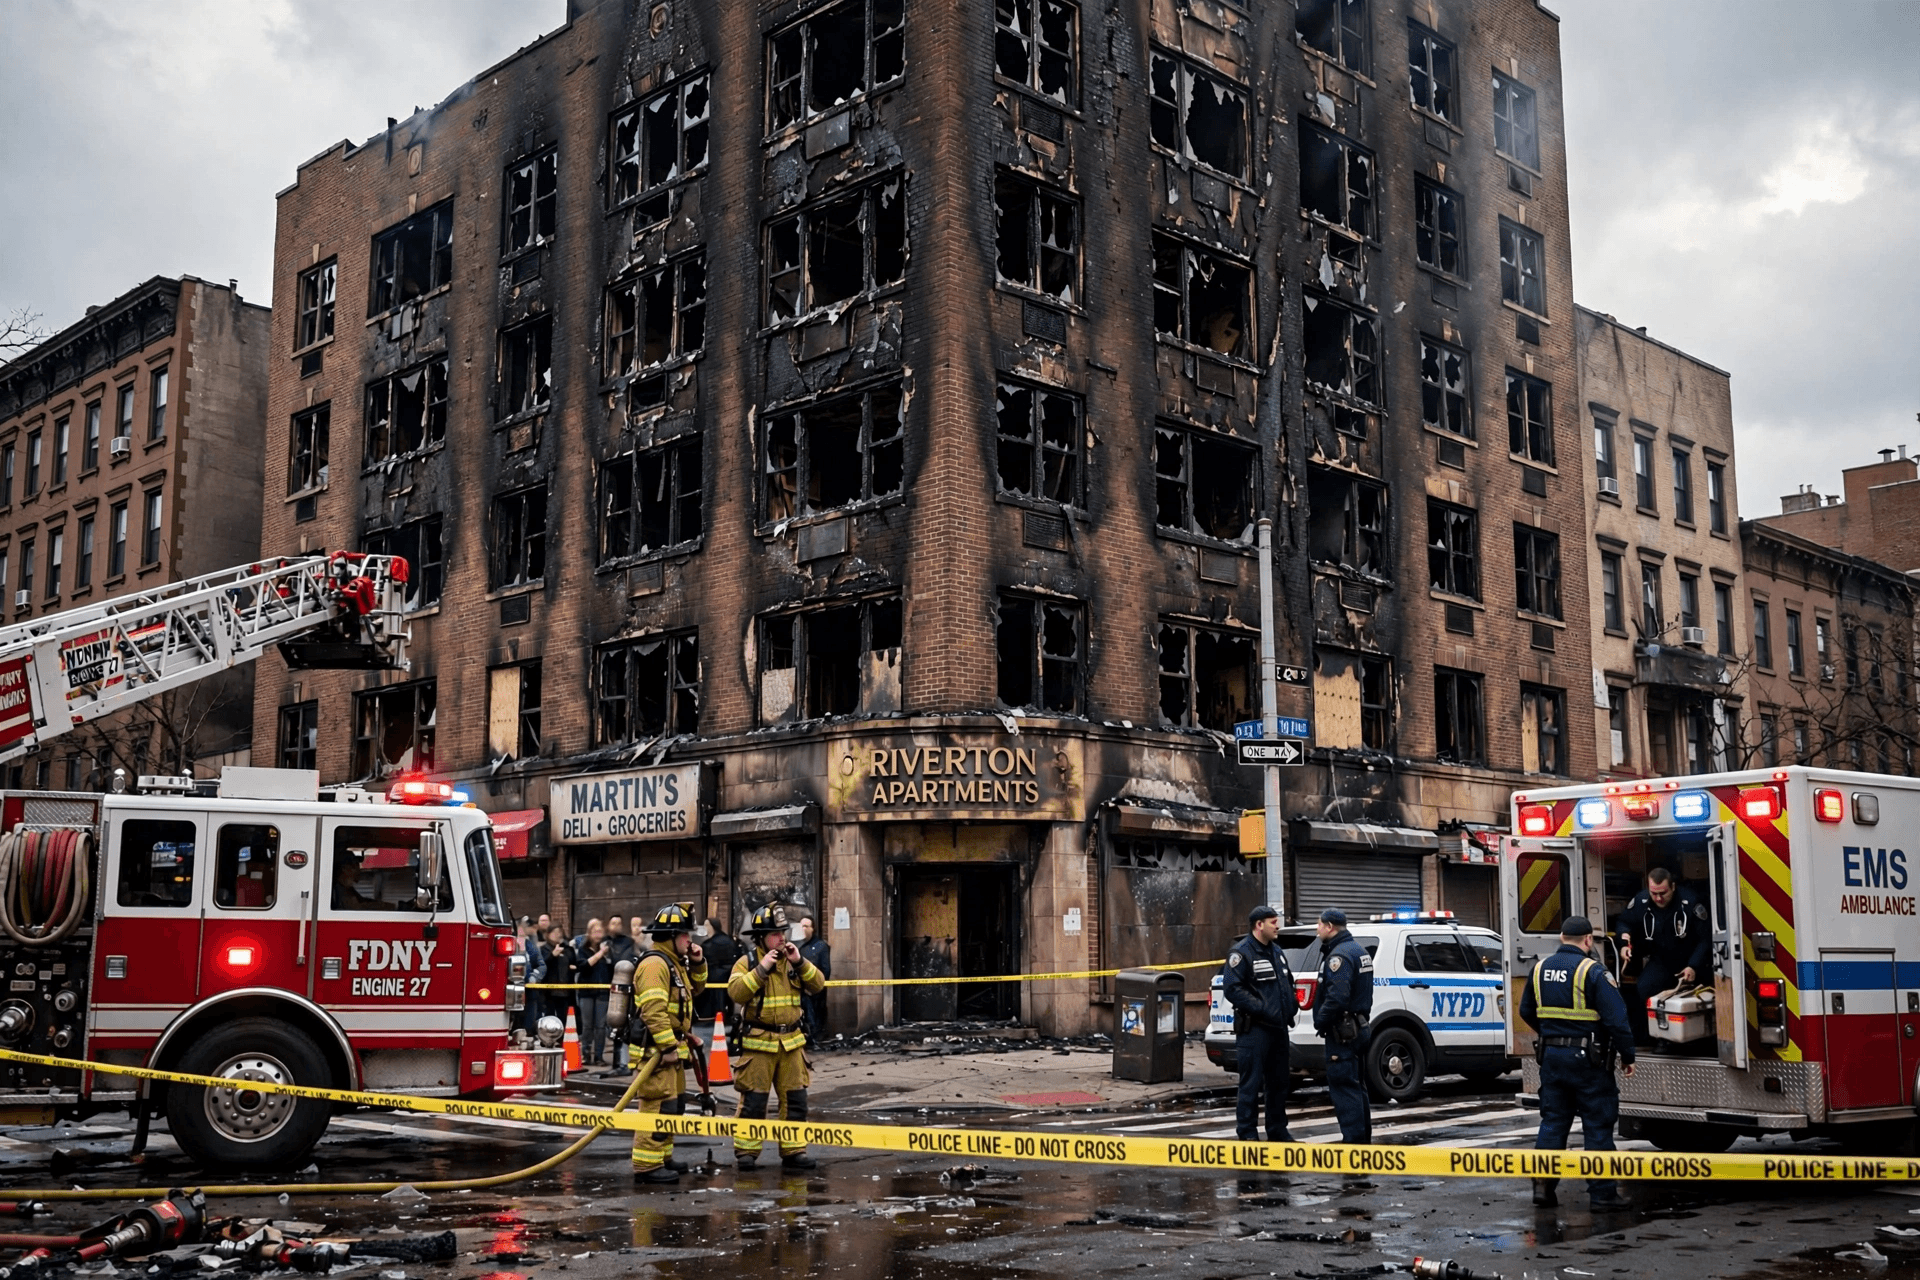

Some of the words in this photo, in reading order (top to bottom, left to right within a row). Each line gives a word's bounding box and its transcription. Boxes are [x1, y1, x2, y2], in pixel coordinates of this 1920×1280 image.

[869, 746, 1037, 777] RIVERTON
[1247, 747, 1266, 756] ONE
[571, 773, 679, 814] MARTIN'S
[872, 780, 1039, 804] APARTMENTS
[563, 817, 591, 839] DELI
[608, 809, 686, 836] GROCERIES
[1842, 846, 1908, 890] EMS
[1840, 894, 1916, 916] AMBULANCE
[352, 977, 405, 996] ENGINE
[409, 977, 431, 996] 27
[1543, 969, 1568, 983] EMS
[1431, 992, 1485, 1017] NYPD
[572, 1114, 615, 1129] CROSS
[655, 1119, 702, 1135] POLICE
[707, 1122, 738, 1137] LINE
[749, 1125, 768, 1140] DO
[772, 1126, 800, 1142] NOT
[804, 1127, 854, 1146] CROSS
[909, 1132, 962, 1152] POLICE
[968, 1135, 1001, 1154] LINE
[1015, 1137, 1035, 1156] DO
[1040, 1138, 1069, 1158] NOT
[1074, 1140, 1126, 1161] CROSS
[1168, 1143, 1226, 1165] POLICE
[1233, 1146, 1269, 1166] LINE
[1284, 1147, 1306, 1168] DO
[1312, 1149, 1344, 1169] NOT
[1349, 1150, 1406, 1170] CROSS
[1450, 1152, 1513, 1174] POLICE
[1521, 1154, 1561, 1175] LINE
[1580, 1156, 1604, 1176] DO
[1610, 1156, 1644, 1177] NOT
[1651, 1157, 1711, 1178] CROSS
[1764, 1159, 1834, 1178] POLICE
[1842, 1161, 1887, 1178] LINE
